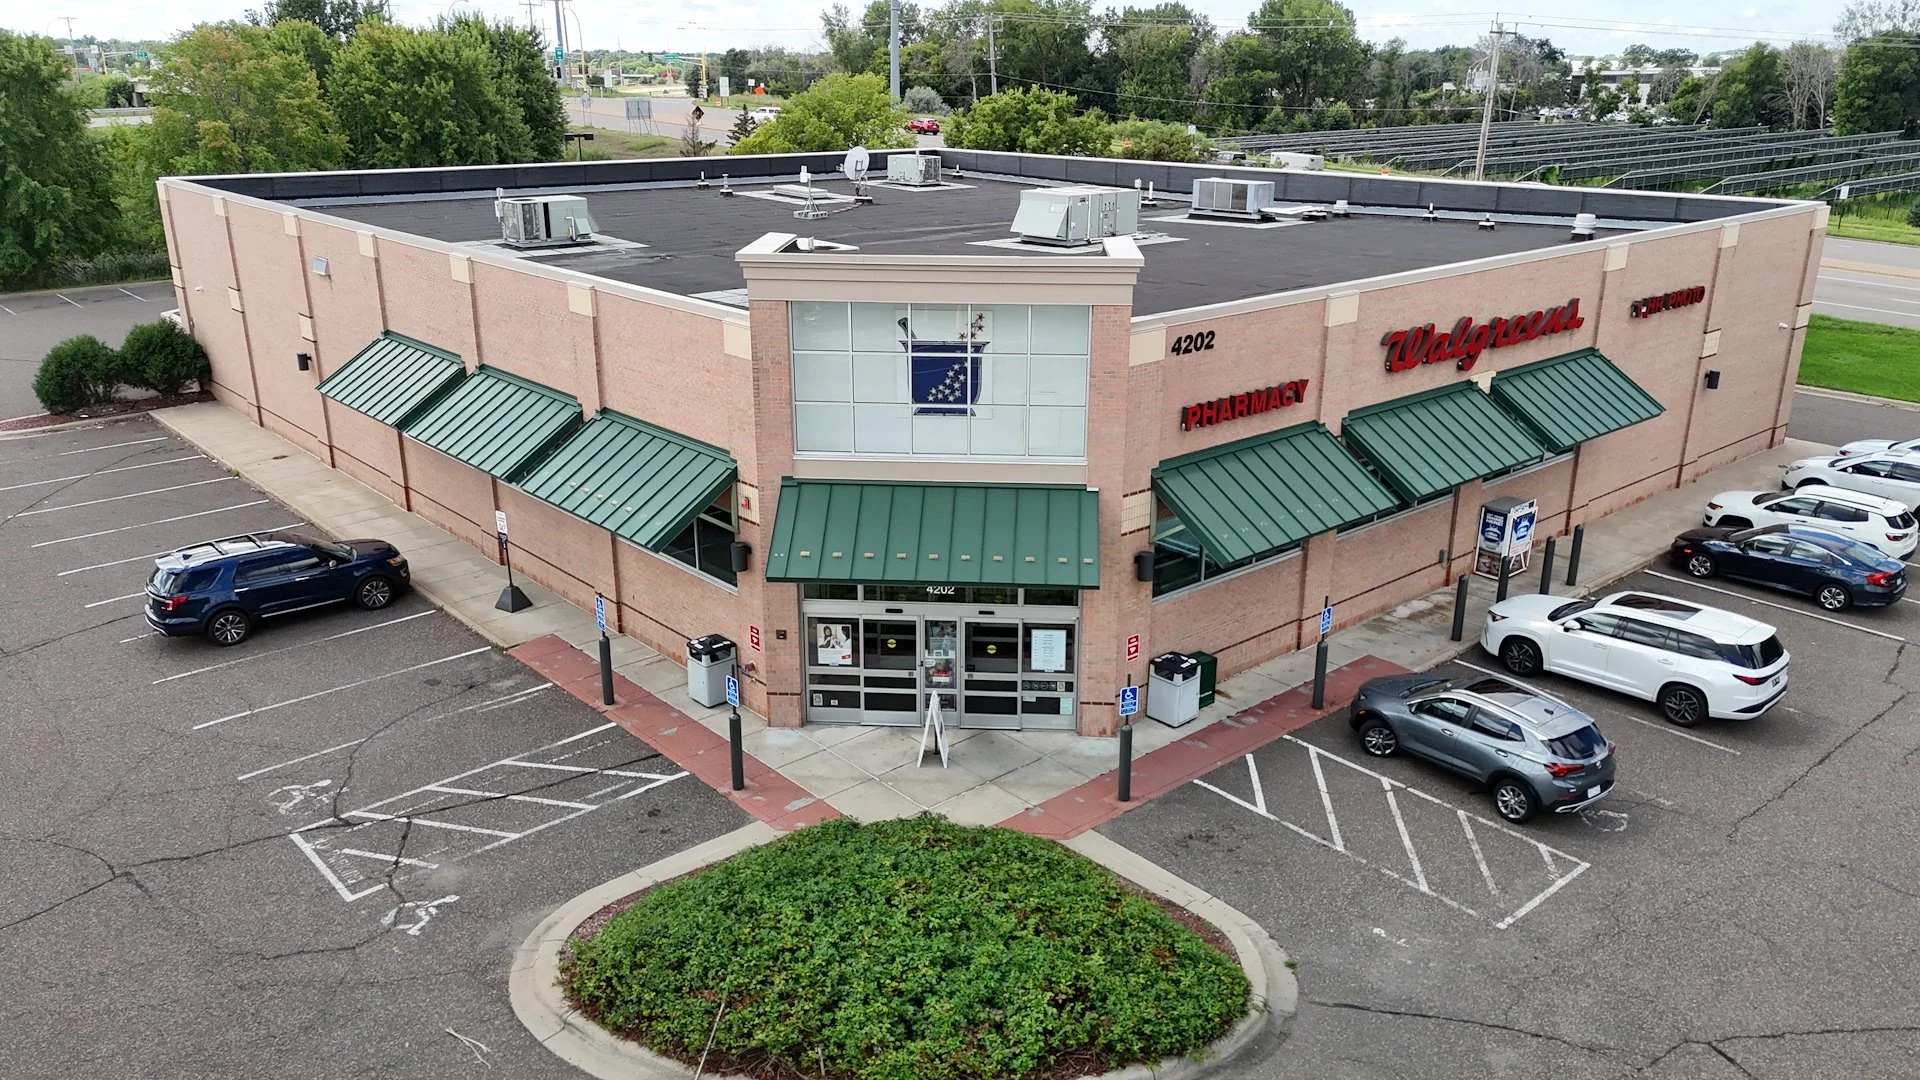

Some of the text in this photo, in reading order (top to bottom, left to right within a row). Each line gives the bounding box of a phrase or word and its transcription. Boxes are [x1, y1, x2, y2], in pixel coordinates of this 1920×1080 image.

[1665, 286, 1706, 309] PHOTO
[1171, 330, 1216, 356] 4202
[1381, 297, 1586, 373] Walgreens
[1181, 379, 1310, 431] PHARMACY
[926, 586, 955, 595] 4202
